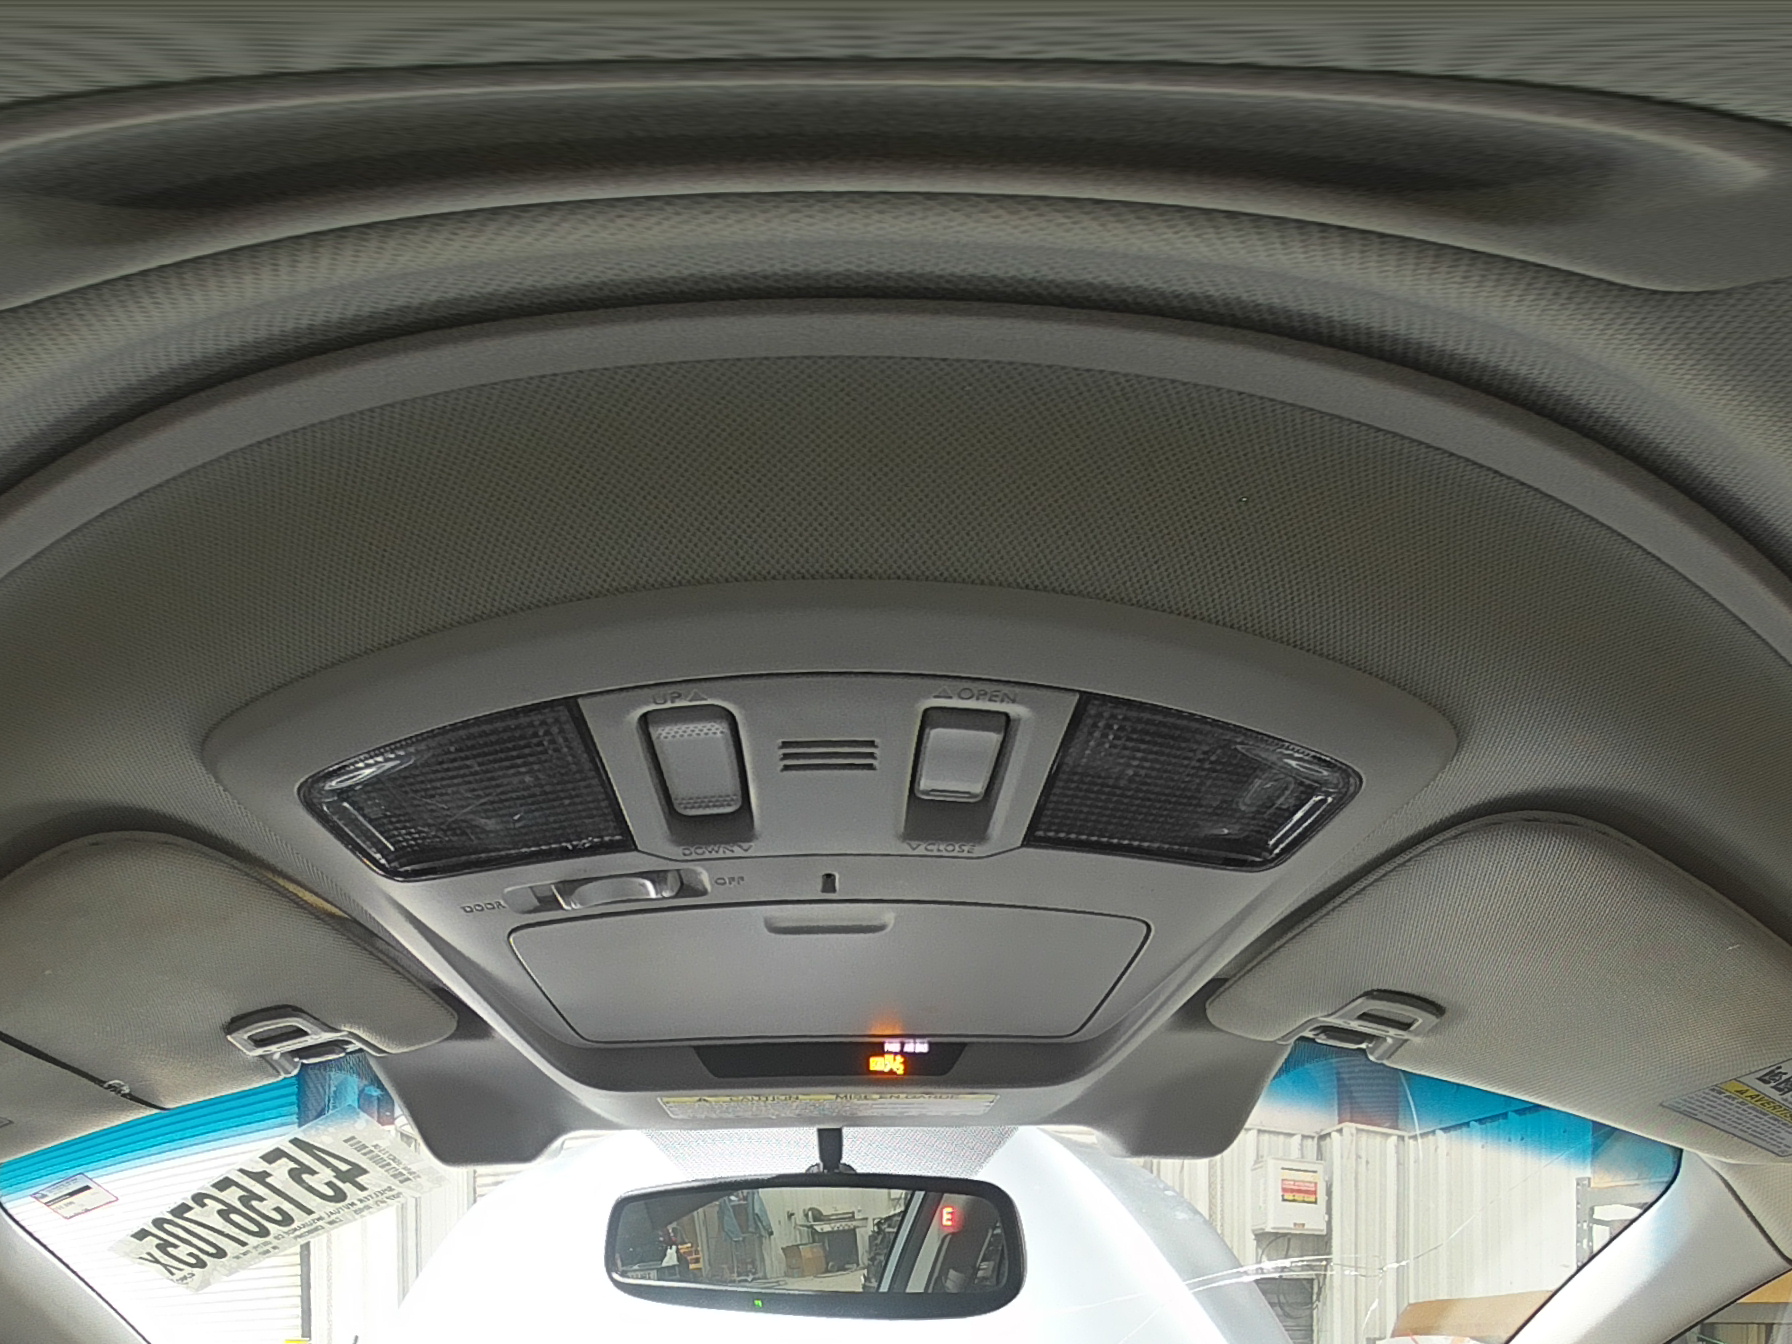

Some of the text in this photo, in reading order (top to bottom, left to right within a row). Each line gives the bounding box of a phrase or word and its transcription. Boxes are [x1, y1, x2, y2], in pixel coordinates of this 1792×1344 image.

[652, 691, 683, 706] UP
[957, 687, 1018, 704] OPEN
[681, 845, 736, 857] DOWN
[924, 842, 977, 854] CLOSE
[714, 876, 745, 887] OFF
[460, 900, 507, 914] DOOR
[942, 1207, 953, 1226] E
